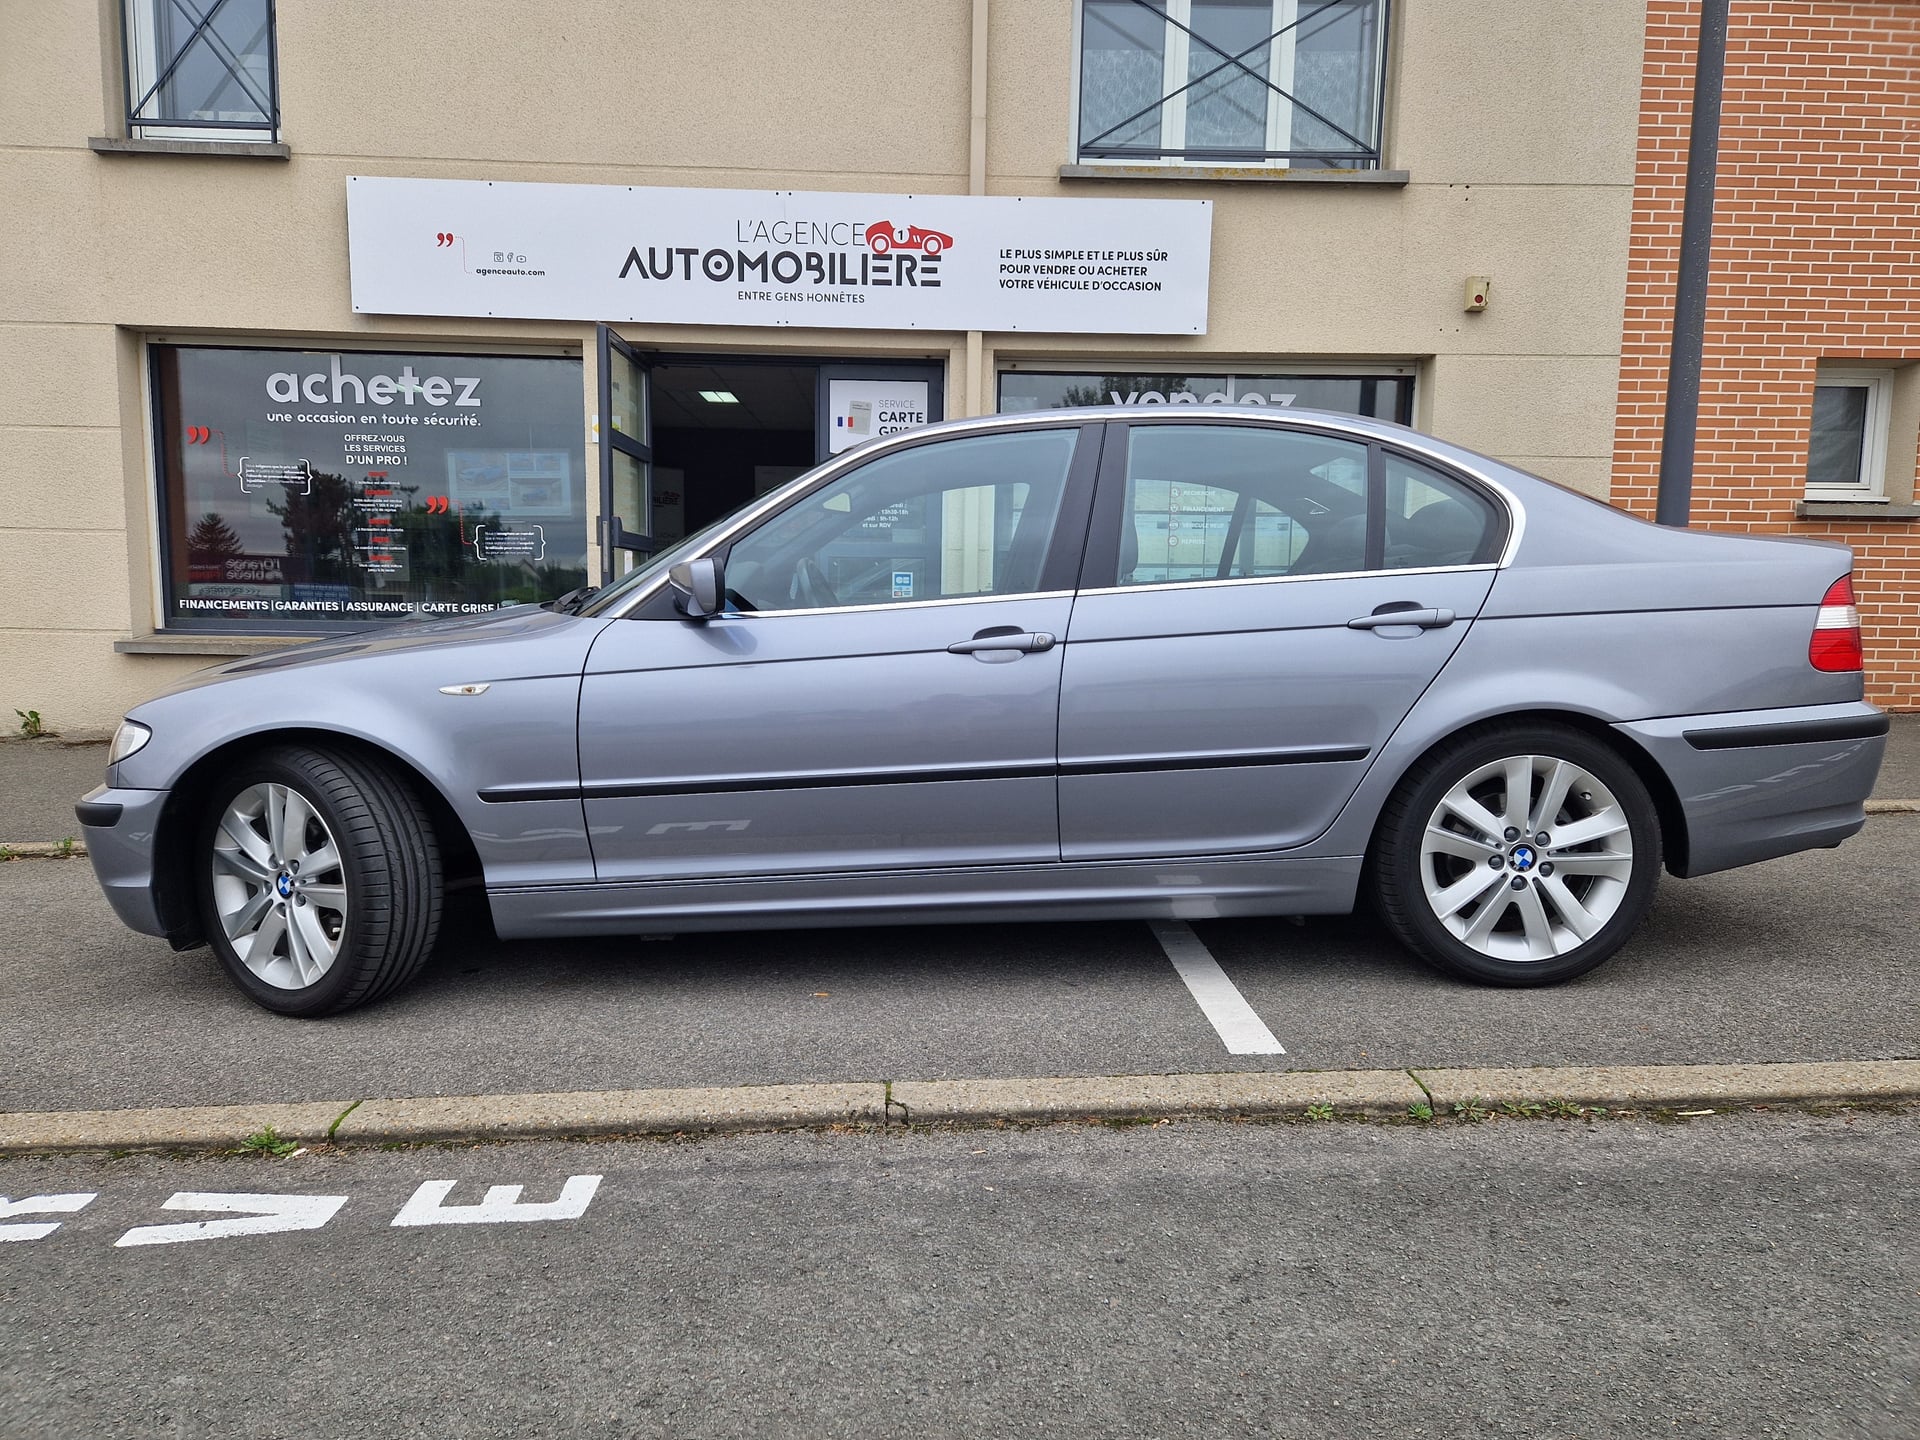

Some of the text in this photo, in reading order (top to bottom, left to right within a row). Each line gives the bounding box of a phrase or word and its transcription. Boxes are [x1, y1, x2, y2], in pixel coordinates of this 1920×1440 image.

[738, 220, 866, 246] L'AGENCE
[1000, 248, 1168, 262] LE PLUS SIMPLE ET LE PLUS SÛR
[476, 268, 546, 277] agenceauto.com
[1000, 264, 1147, 277] POUR VENDRE OU ACHETER
[1000, 276, 1162, 292] VOTRE VÉHICULE D'OCCASION
[738, 291, 865, 304] ENTRE GENS HONNÊTES
[266, 354, 481, 407] achetez
[879, 400, 915, 408] SERVICE
[267, 412, 481, 427] une occasion en toute sécurité.
[879, 411, 923, 423] CARTE
[344, 434, 405, 443] OFFREZ-VOUS
[344, 444, 406, 453] LES SERVICES
[346, 455, 374, 465] D'UN
[377, 455, 401, 465] PRO
[179, 599, 268, 610] FINANCEMENTS
[275, 600, 339, 611] GARANTIES
[346, 602, 413, 612] ASSURANCE
[421, 602, 459, 613] CARTE
